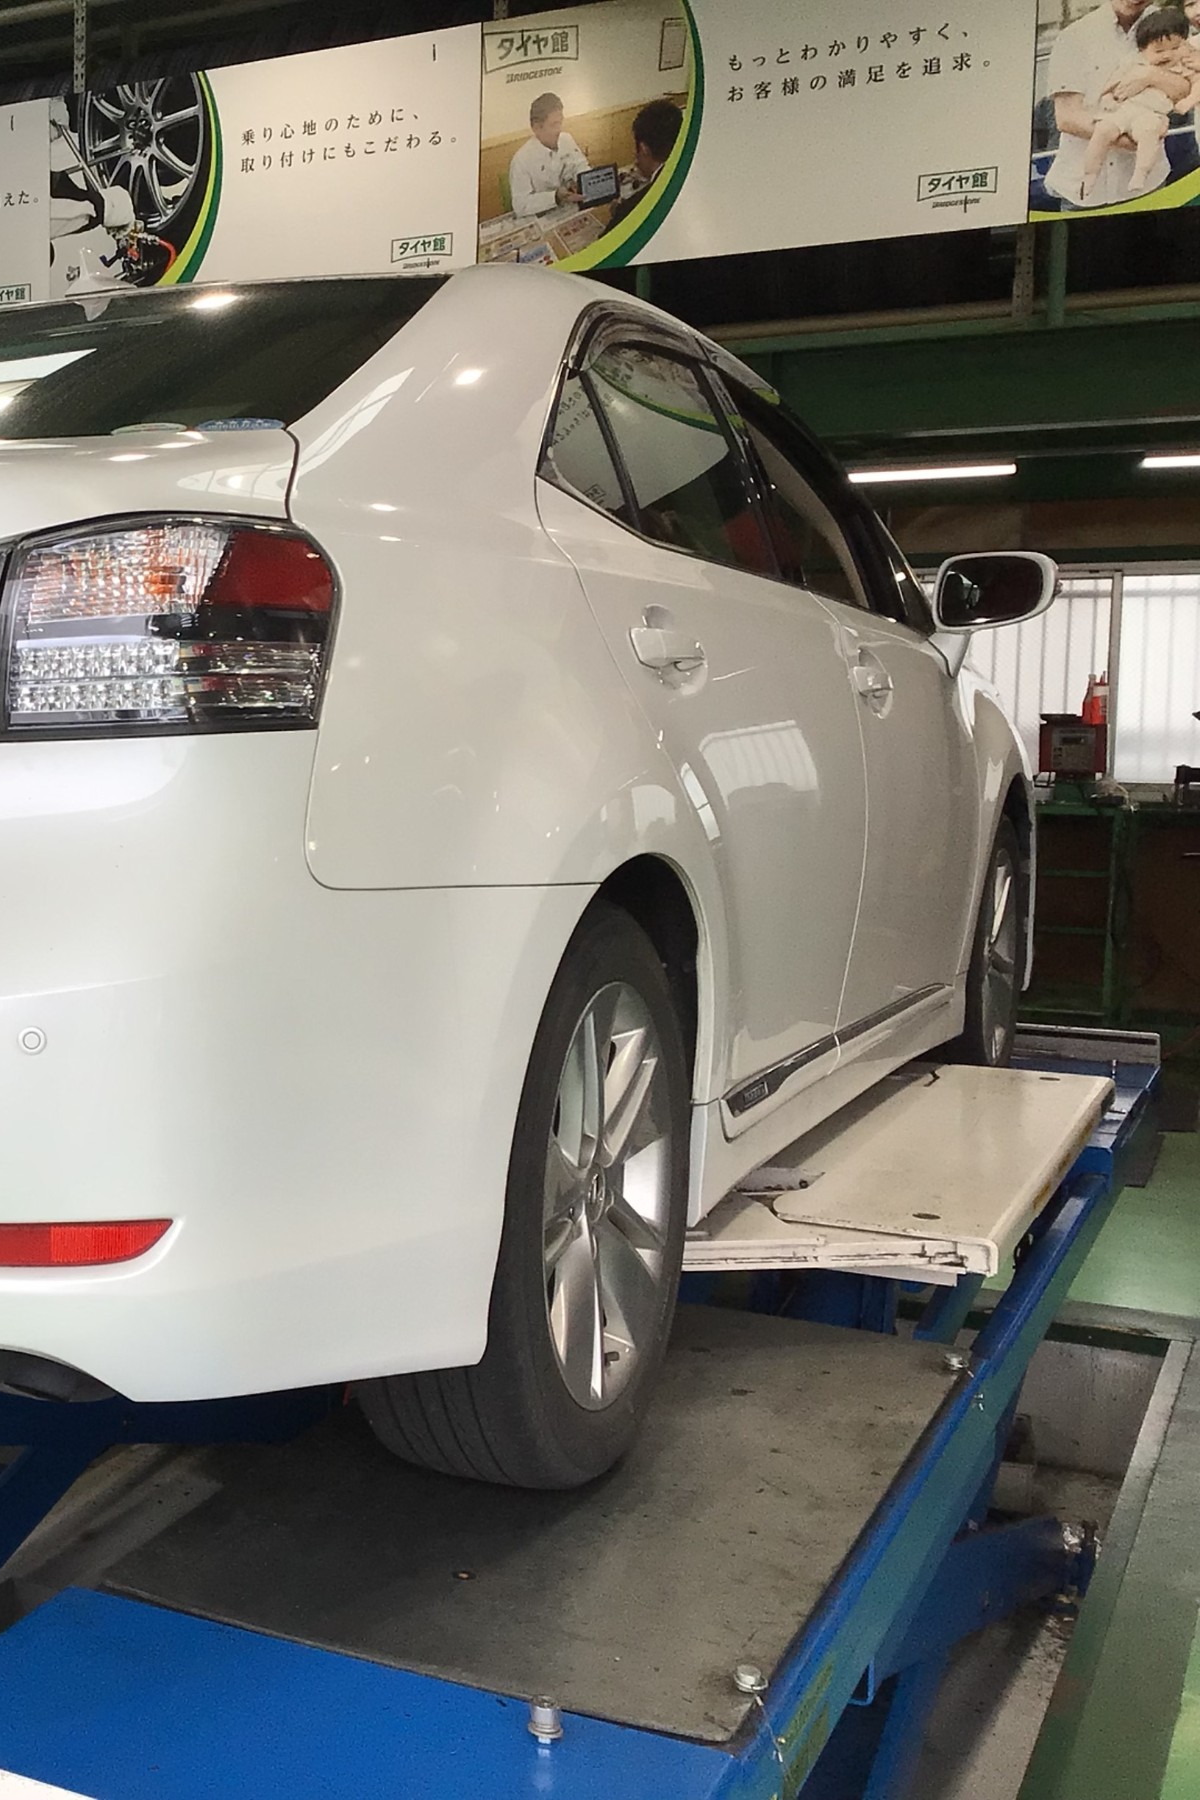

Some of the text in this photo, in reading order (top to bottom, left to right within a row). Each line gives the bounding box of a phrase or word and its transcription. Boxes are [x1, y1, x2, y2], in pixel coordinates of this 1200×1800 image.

[497, 30, 570, 60] タイヤ館
[727, 22, 970, 72] もっとわかりやすく、
[505, 66, 563, 84] BRIDGESTONE
[726, 52, 992, 103] お客様の満足を追求。
[241, 108, 420, 146] 乗り心地のために、
[240, 130, 458, 173] 取り付けにもこだわる。
[927, 171, 989, 193] タイヤ館
[398, 237, 446, 255] タイヤ館
